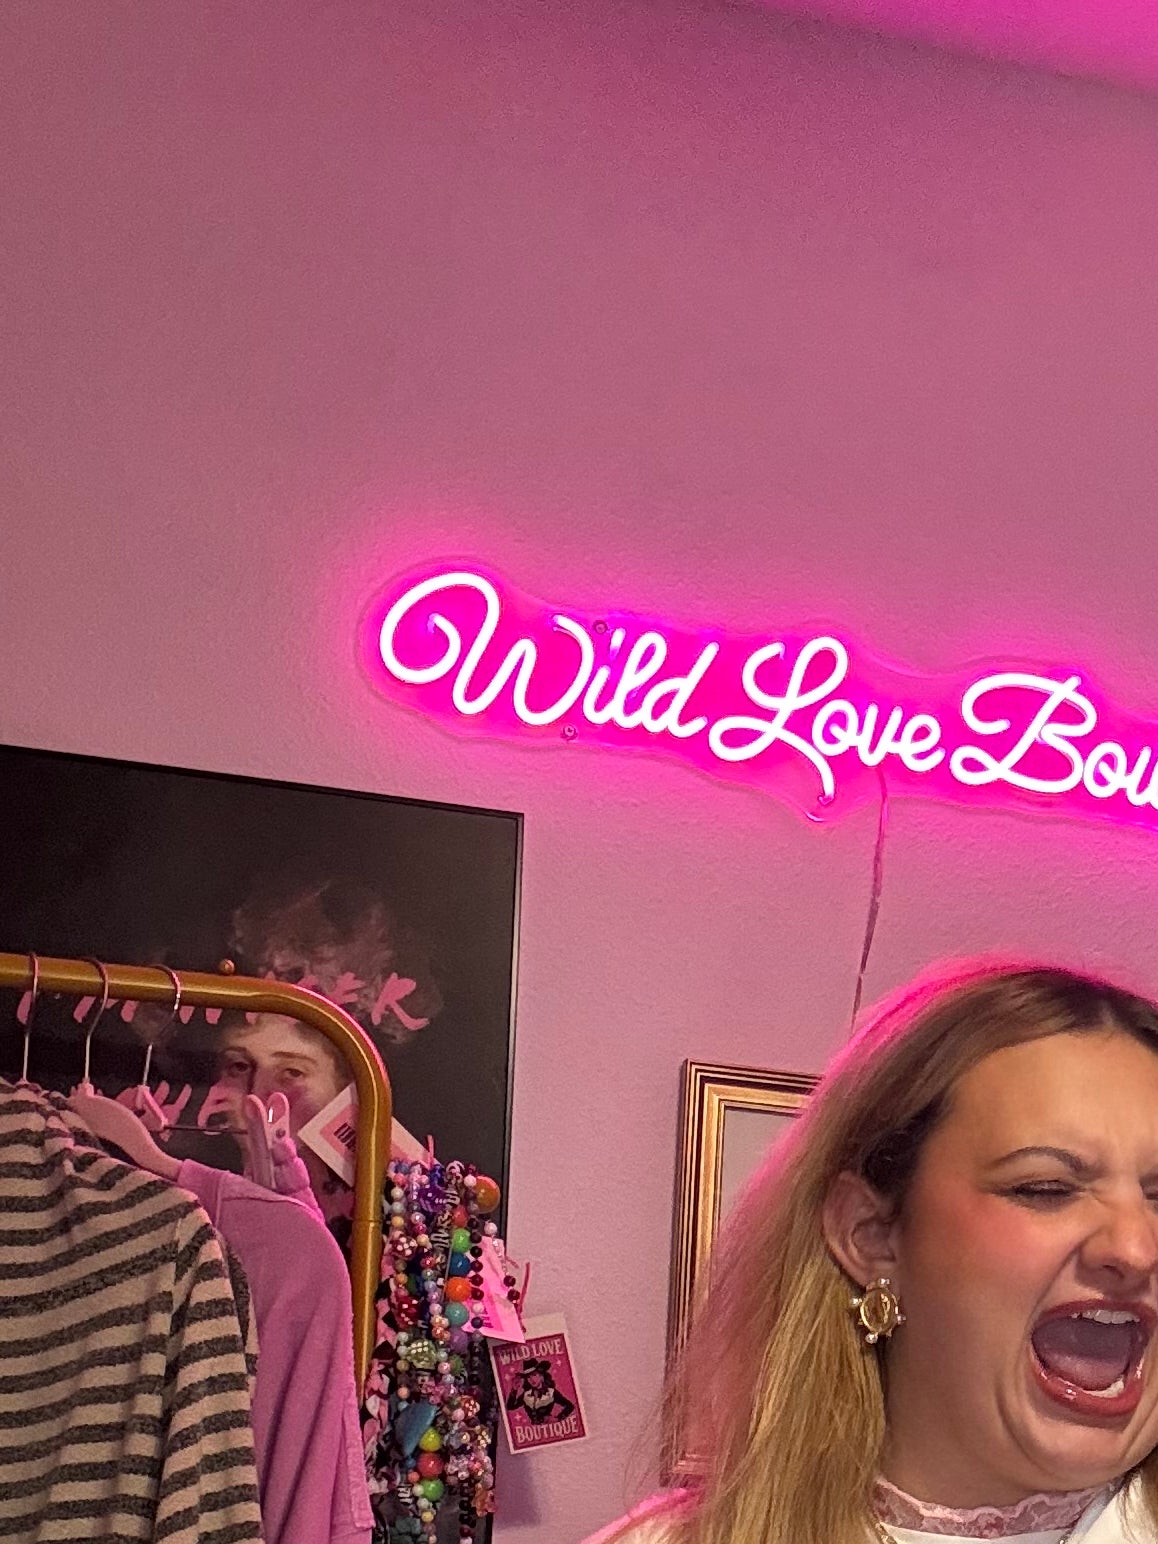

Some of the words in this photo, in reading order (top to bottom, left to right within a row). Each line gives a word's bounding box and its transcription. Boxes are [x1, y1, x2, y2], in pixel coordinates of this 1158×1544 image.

[380, 571, 718, 738] Wild
[709, 635, 942, 806] Love
[500, 1345, 531, 1365] WILD
[532, 1338, 564, 1357] LOVE
[516, 1415, 578, 1443] BOUTIQUE
